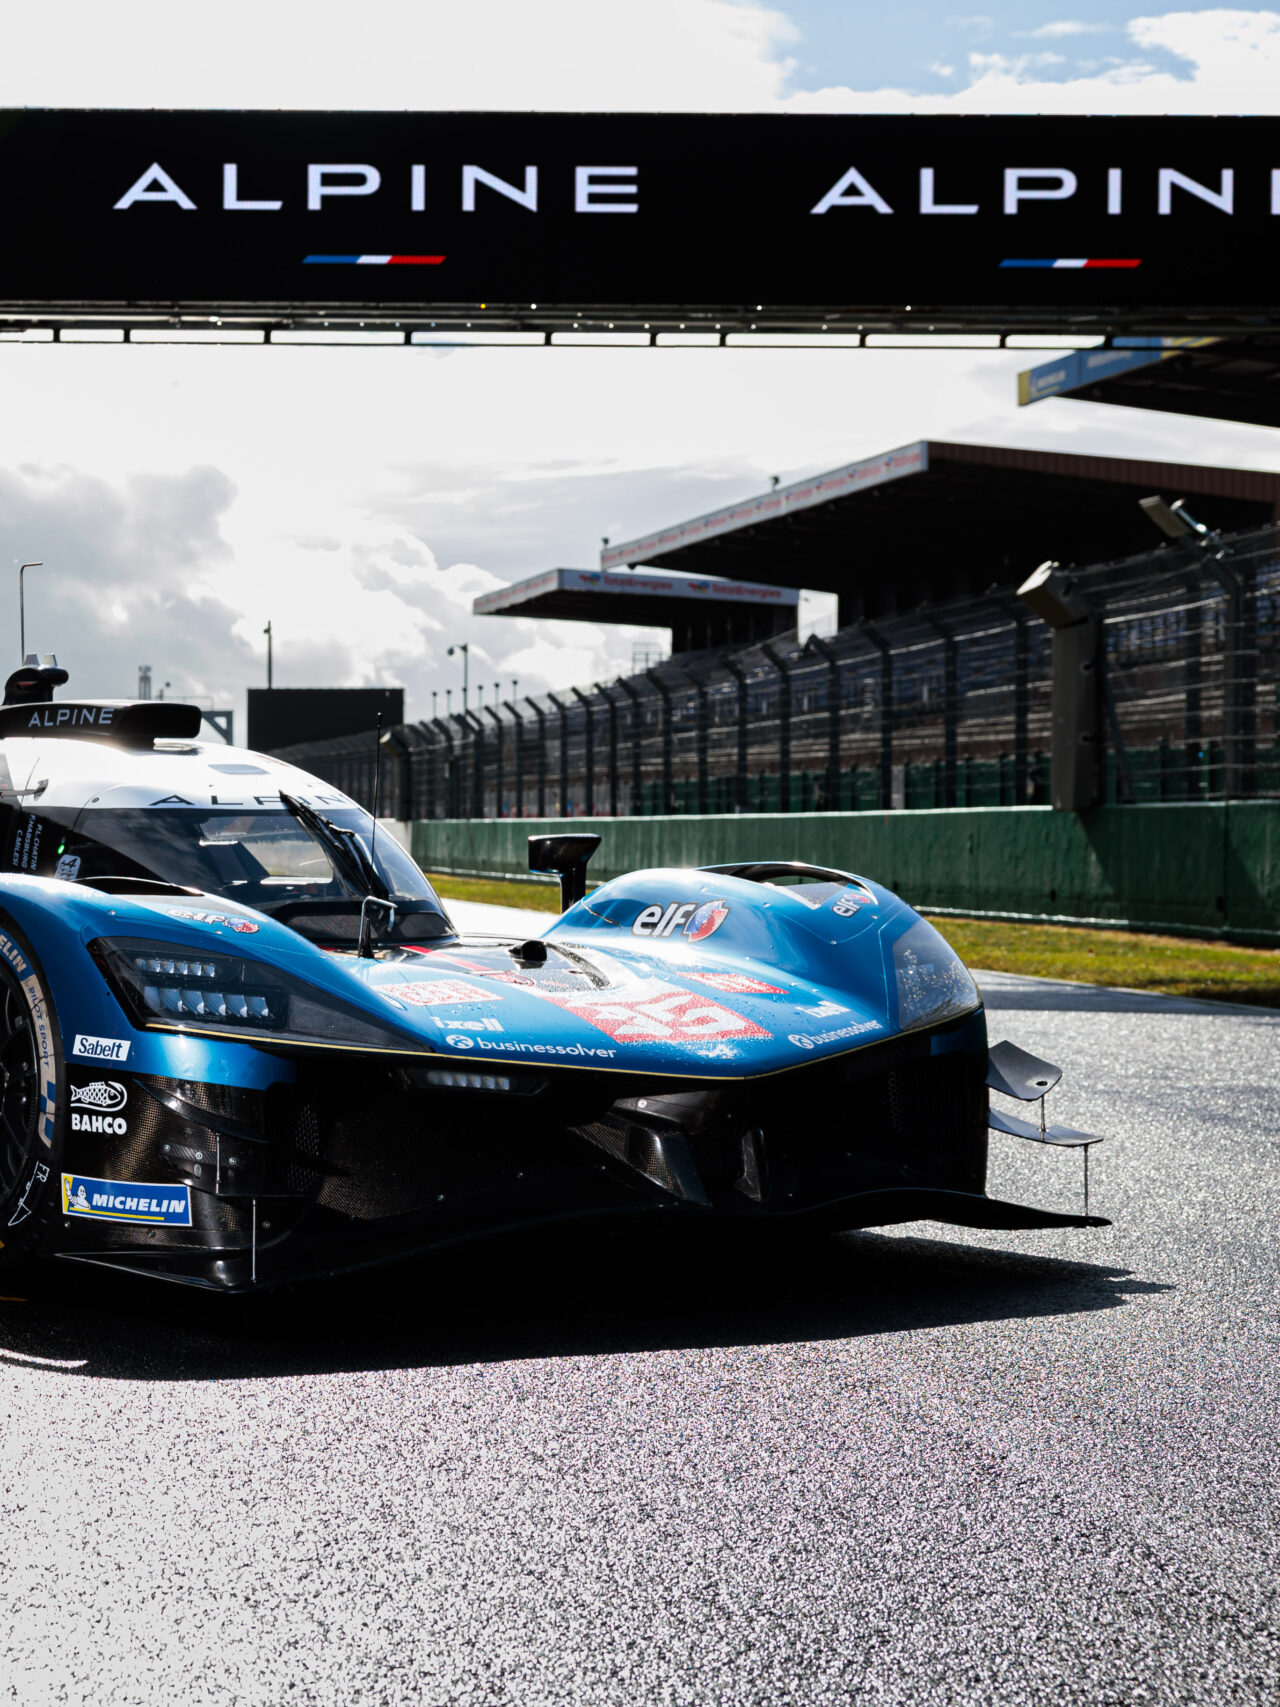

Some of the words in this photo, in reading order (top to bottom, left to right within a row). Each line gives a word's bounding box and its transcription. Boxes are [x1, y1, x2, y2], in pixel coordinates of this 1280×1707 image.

[113, 163, 639, 213] ALPINE
[810, 166, 1280, 215] ALPIN
[28, 707, 115, 728] ALPINE
[832, 893, 862, 917] elf
[631, 902, 697, 937] elf
[28, 986, 43, 1020] PILOT
[38, 1024, 50, 1069] SPORT
[430, 1016, 505, 1032] ixell
[801, 1020, 883, 1045] businessolver
[78, 1037, 123, 1059] Sabelt
[477, 1037, 617, 1059] businessolver
[72, 1113, 128, 1135] BAHCO
[91, 1193, 187, 1214] MICHELIN
